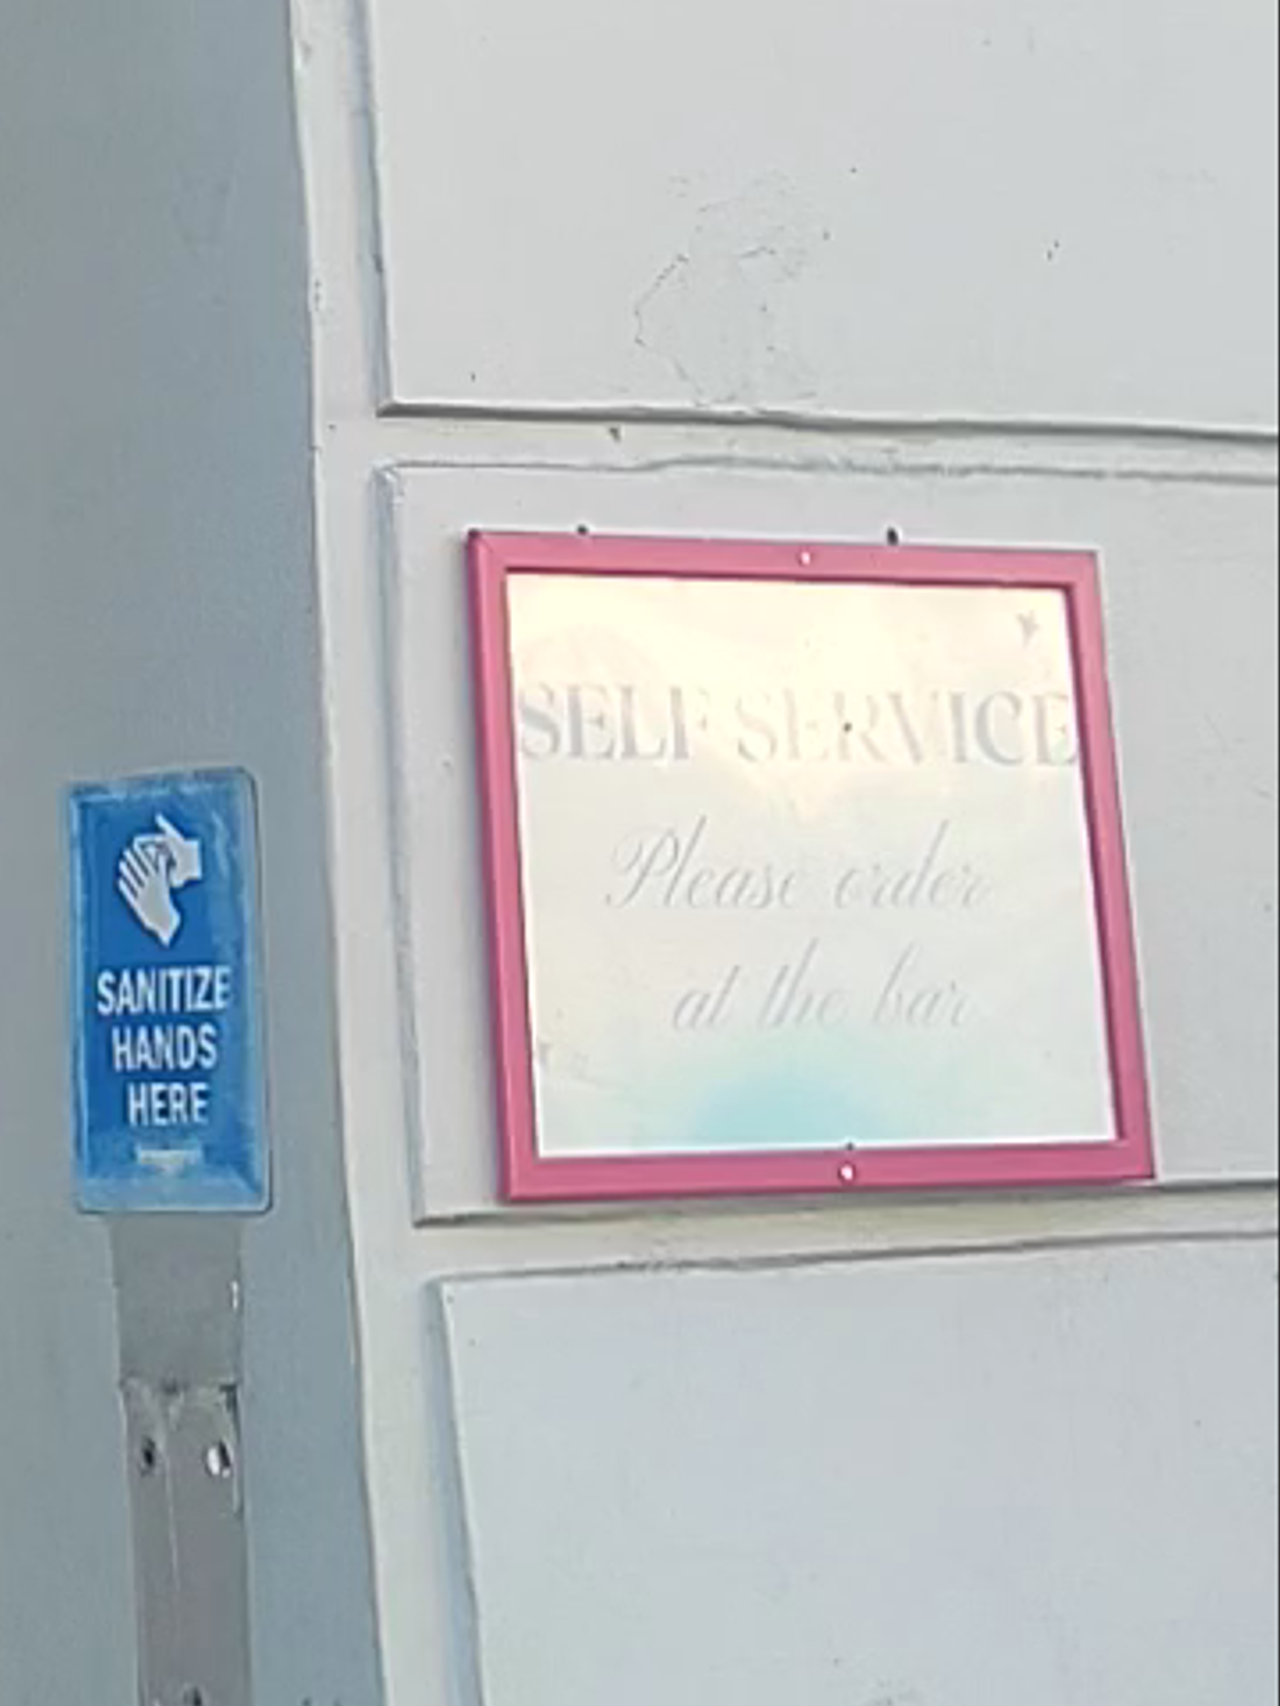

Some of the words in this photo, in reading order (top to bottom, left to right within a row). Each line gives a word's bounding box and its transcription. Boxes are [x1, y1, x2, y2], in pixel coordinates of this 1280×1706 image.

[518, 682, 710, 763] SELF
[735, 688, 1079, 767] SERVICE
[605, 815, 796, 910] Please
[834, 820, 991, 910] order
[97, 965, 231, 1015] SANITIZE
[671, 963, 742, 1032] at
[756, 937, 844, 1030] the
[872, 943, 970, 1028] bar
[112, 1023, 218, 1071] HANDS
[128, 1083, 210, 1127] HERE
